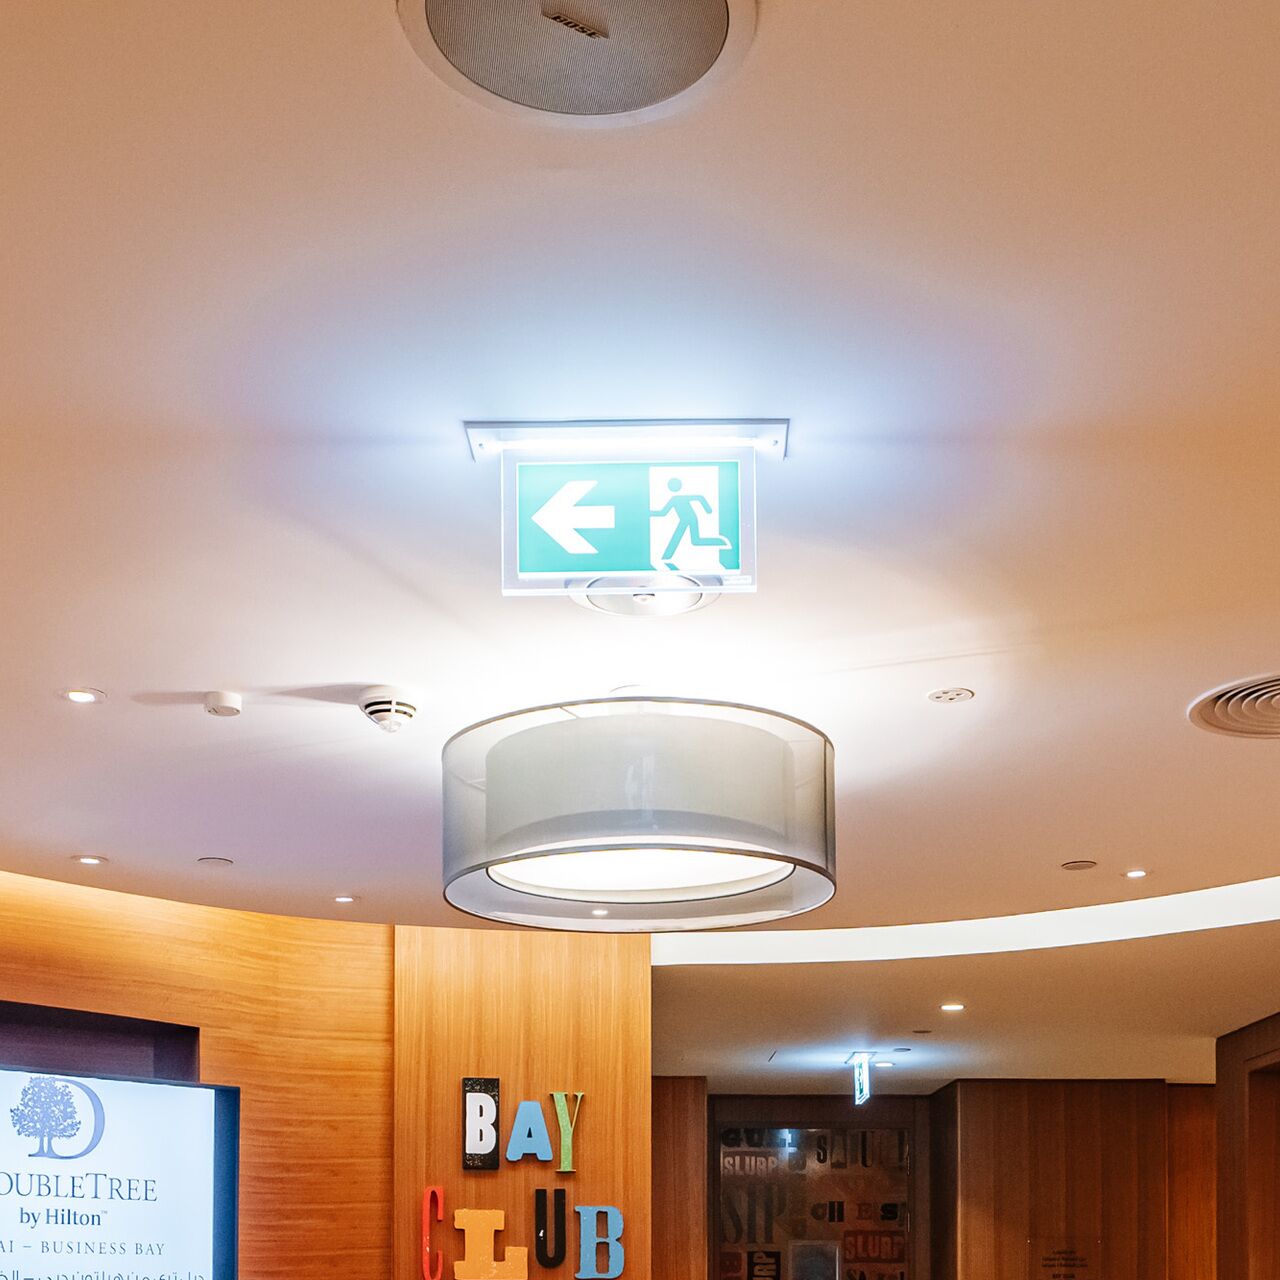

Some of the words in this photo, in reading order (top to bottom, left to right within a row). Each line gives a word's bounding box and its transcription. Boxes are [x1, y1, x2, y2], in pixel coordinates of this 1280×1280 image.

[462, 1078, 584, 1173] BAY
[723, 1154, 779, 1177] SLURP
[19, 1208, 41, 1229] by
[40, 1240, 127, 1256] BUSINESS
[134, 1242, 165, 1256] BAY
